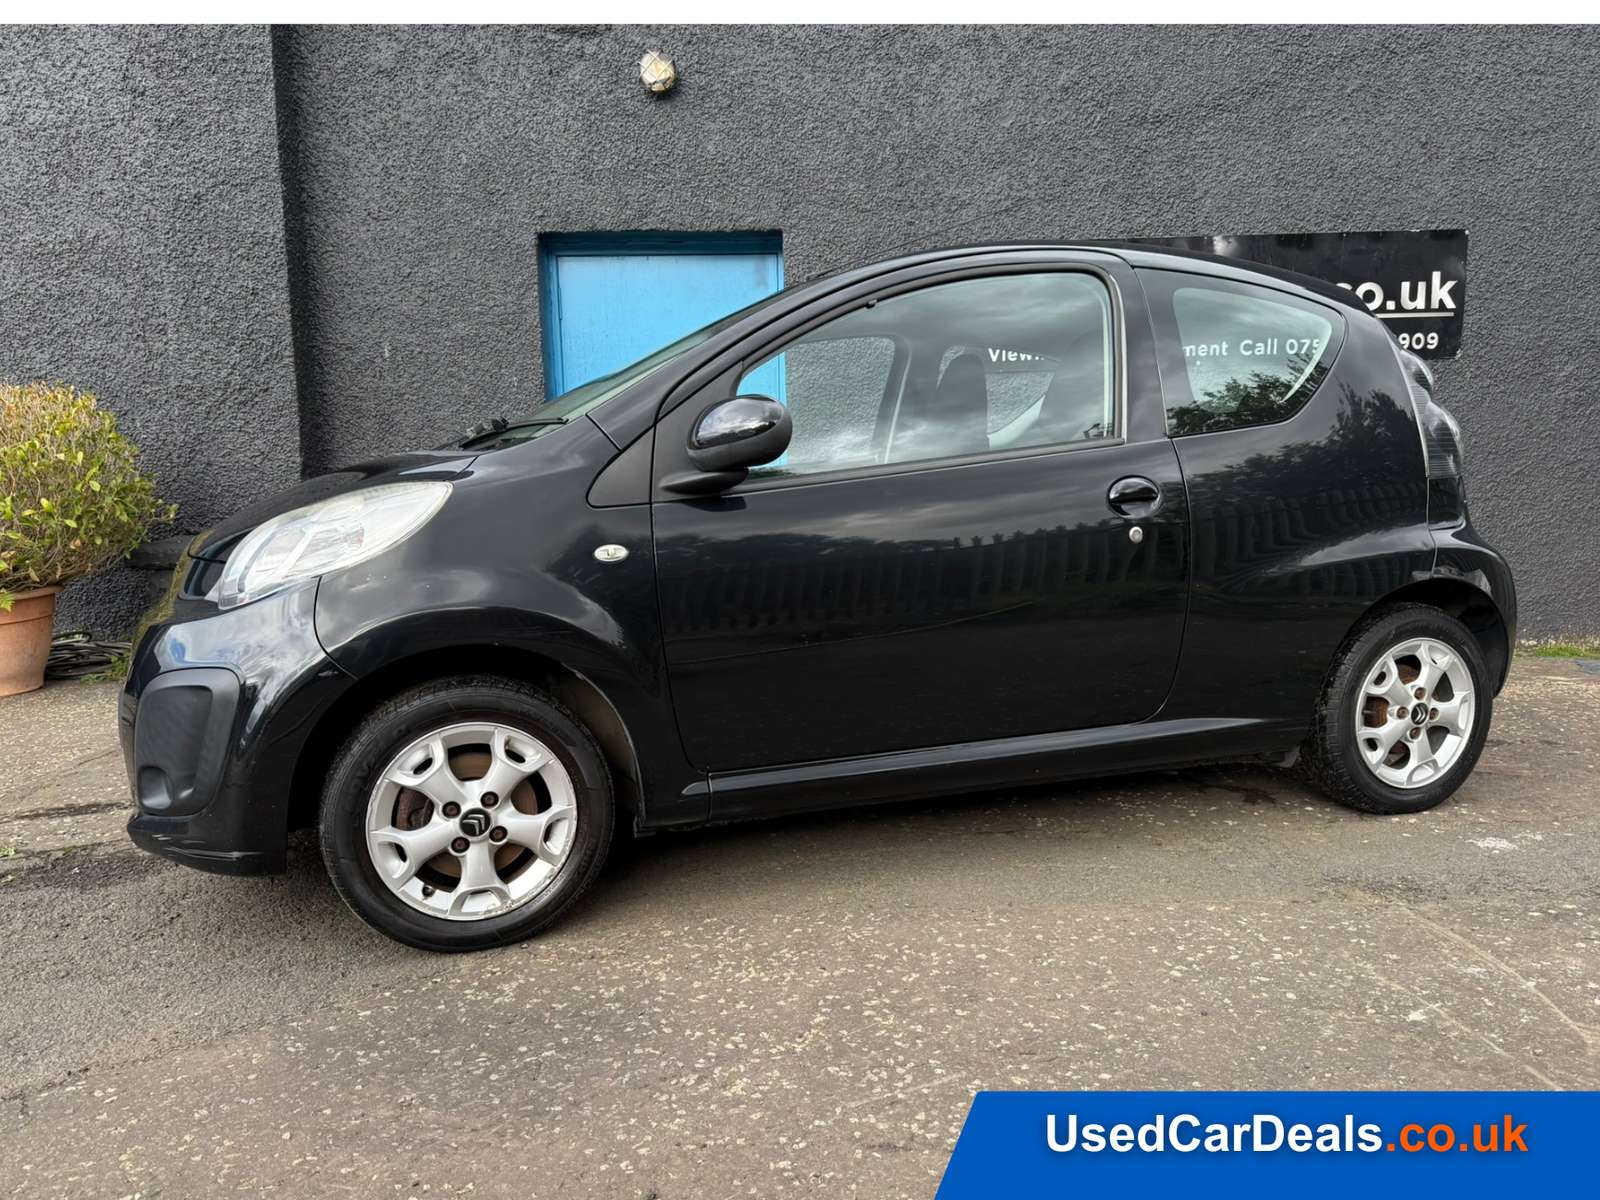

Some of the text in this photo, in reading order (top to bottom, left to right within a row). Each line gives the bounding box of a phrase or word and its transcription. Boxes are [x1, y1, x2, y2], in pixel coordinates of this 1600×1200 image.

[1336, 271, 1458, 311] o.uk
[987, 347, 1044, 362] View
[1239, 338, 1278, 356] Call
[1398, 332, 1439, 350] 909
